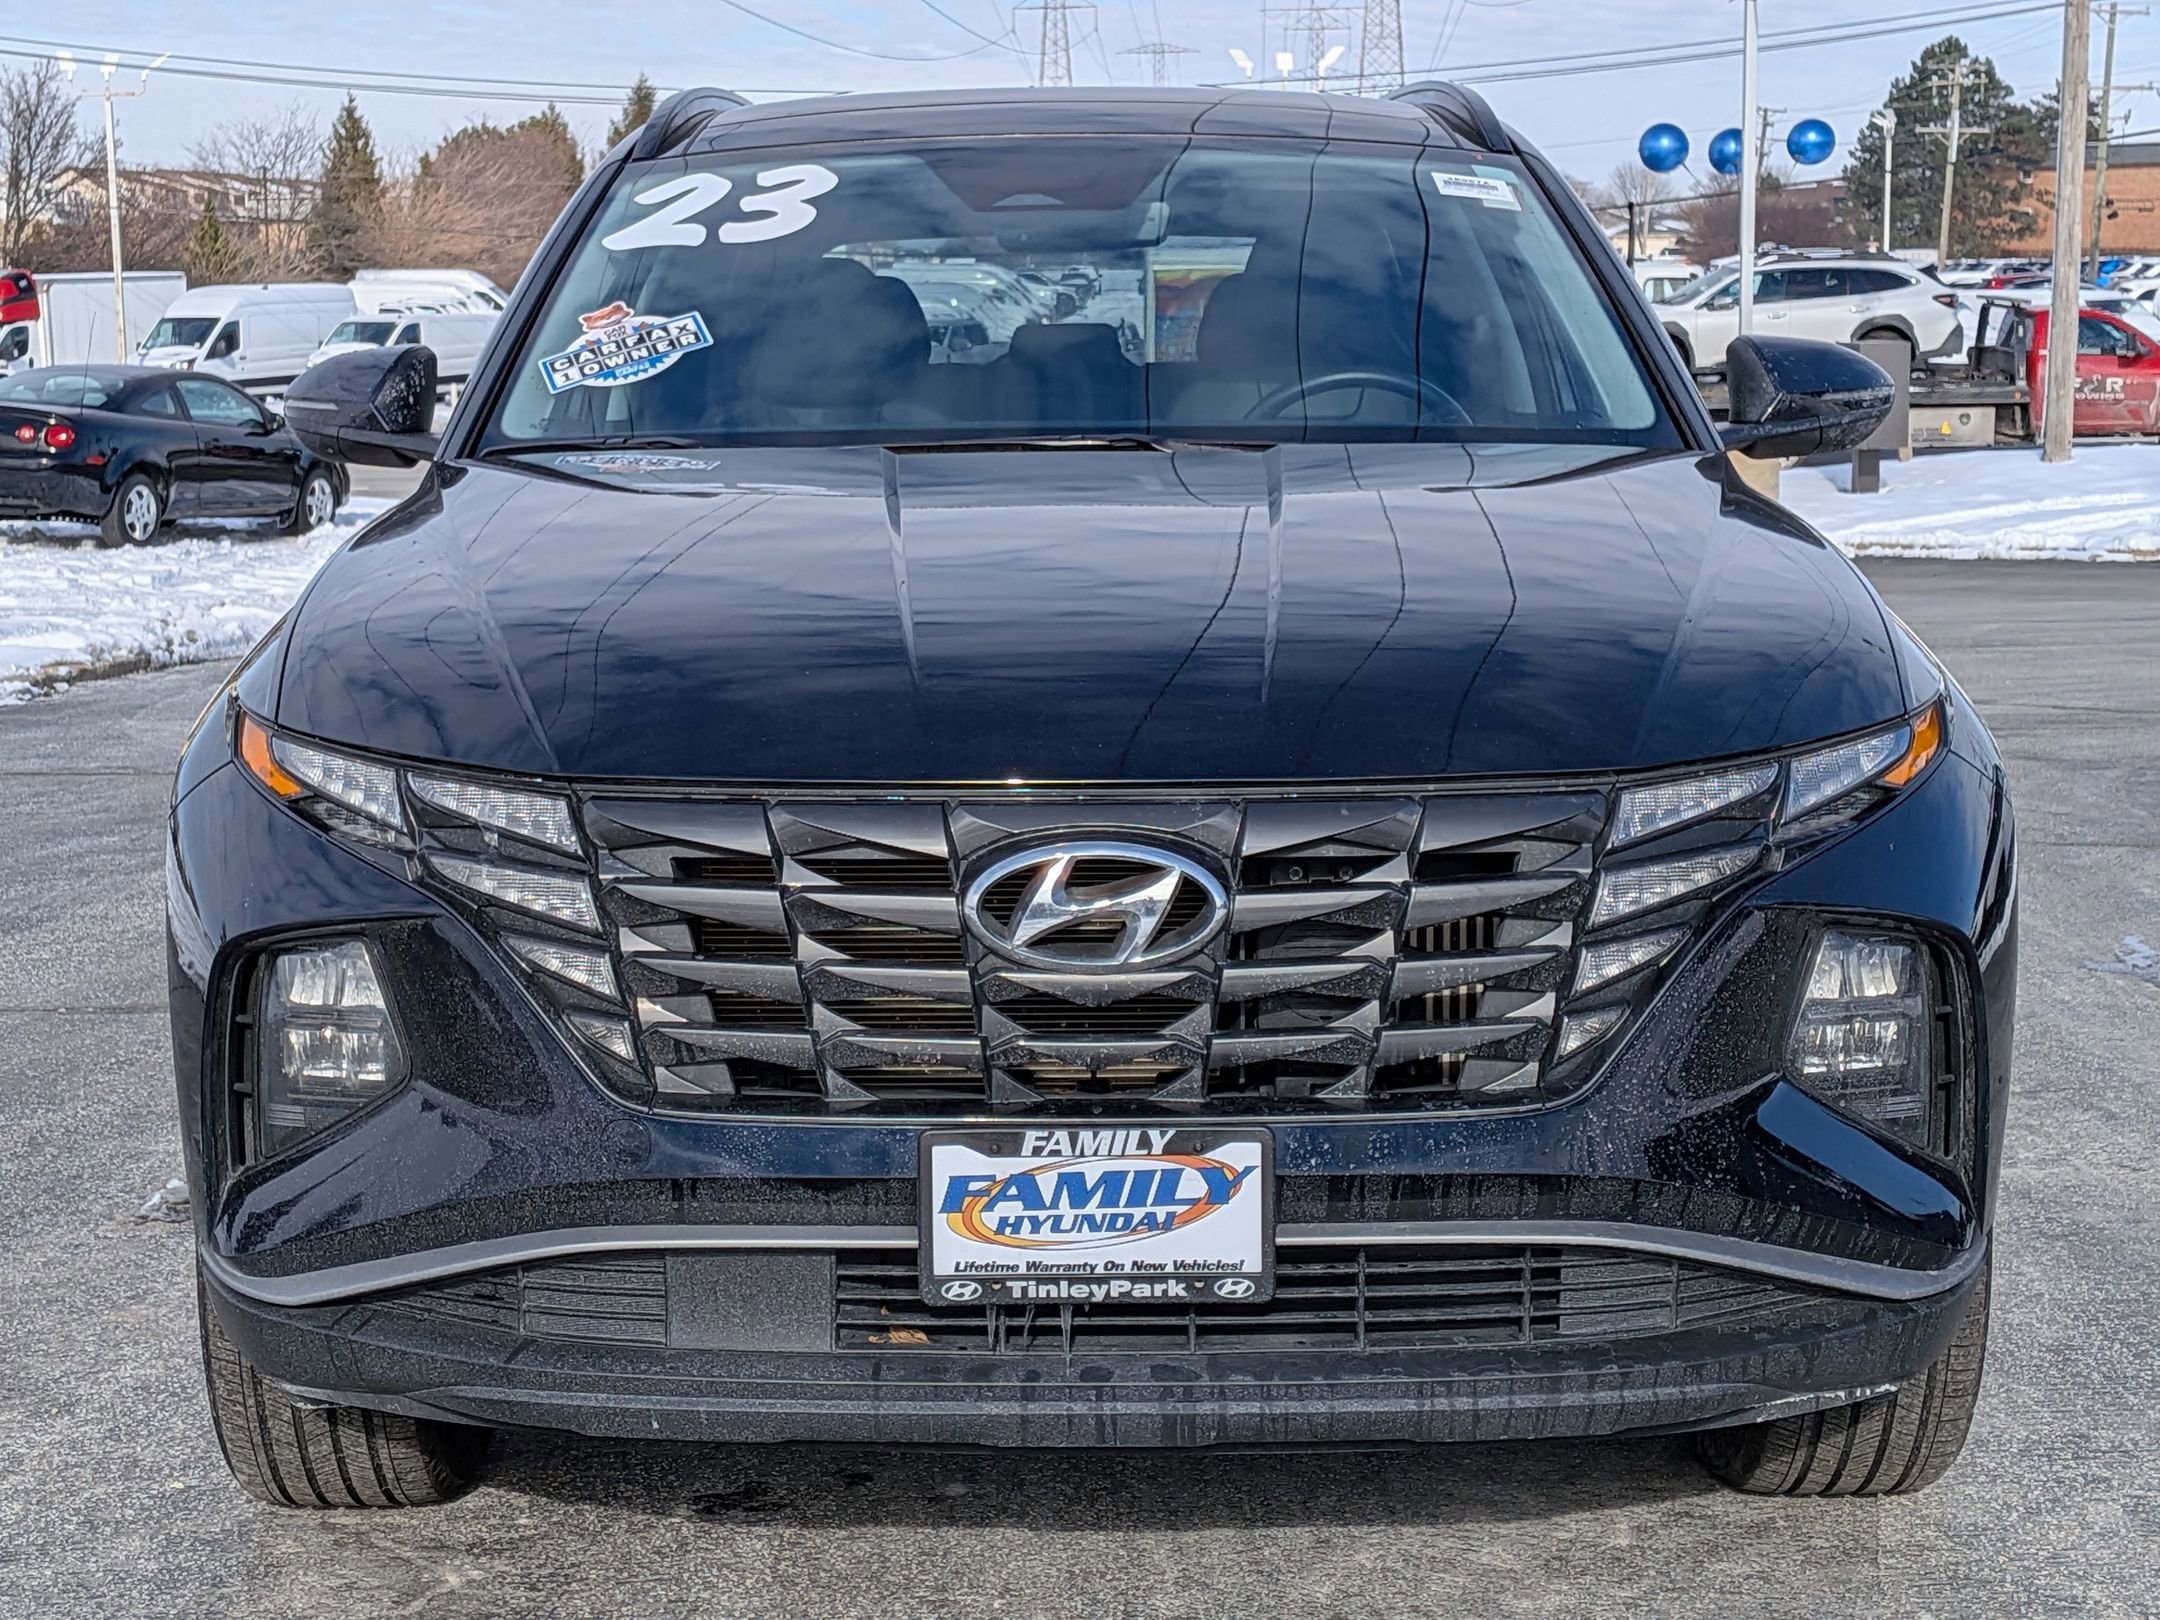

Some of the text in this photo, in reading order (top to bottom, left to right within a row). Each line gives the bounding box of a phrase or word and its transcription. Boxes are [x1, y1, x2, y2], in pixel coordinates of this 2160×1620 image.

[601, 164, 839, 250] 23
[552, 322, 690, 372] CARFAX
[582, 335, 698, 376] OWNER
[1020, 1130, 1176, 1156] FAMILY
[938, 1165, 1259, 1214] FAMILY
[994, 1211, 1177, 1235] HYUNDAI
[954, 1259, 1245, 1274] Lifetime Warranty On New Vehicles!
